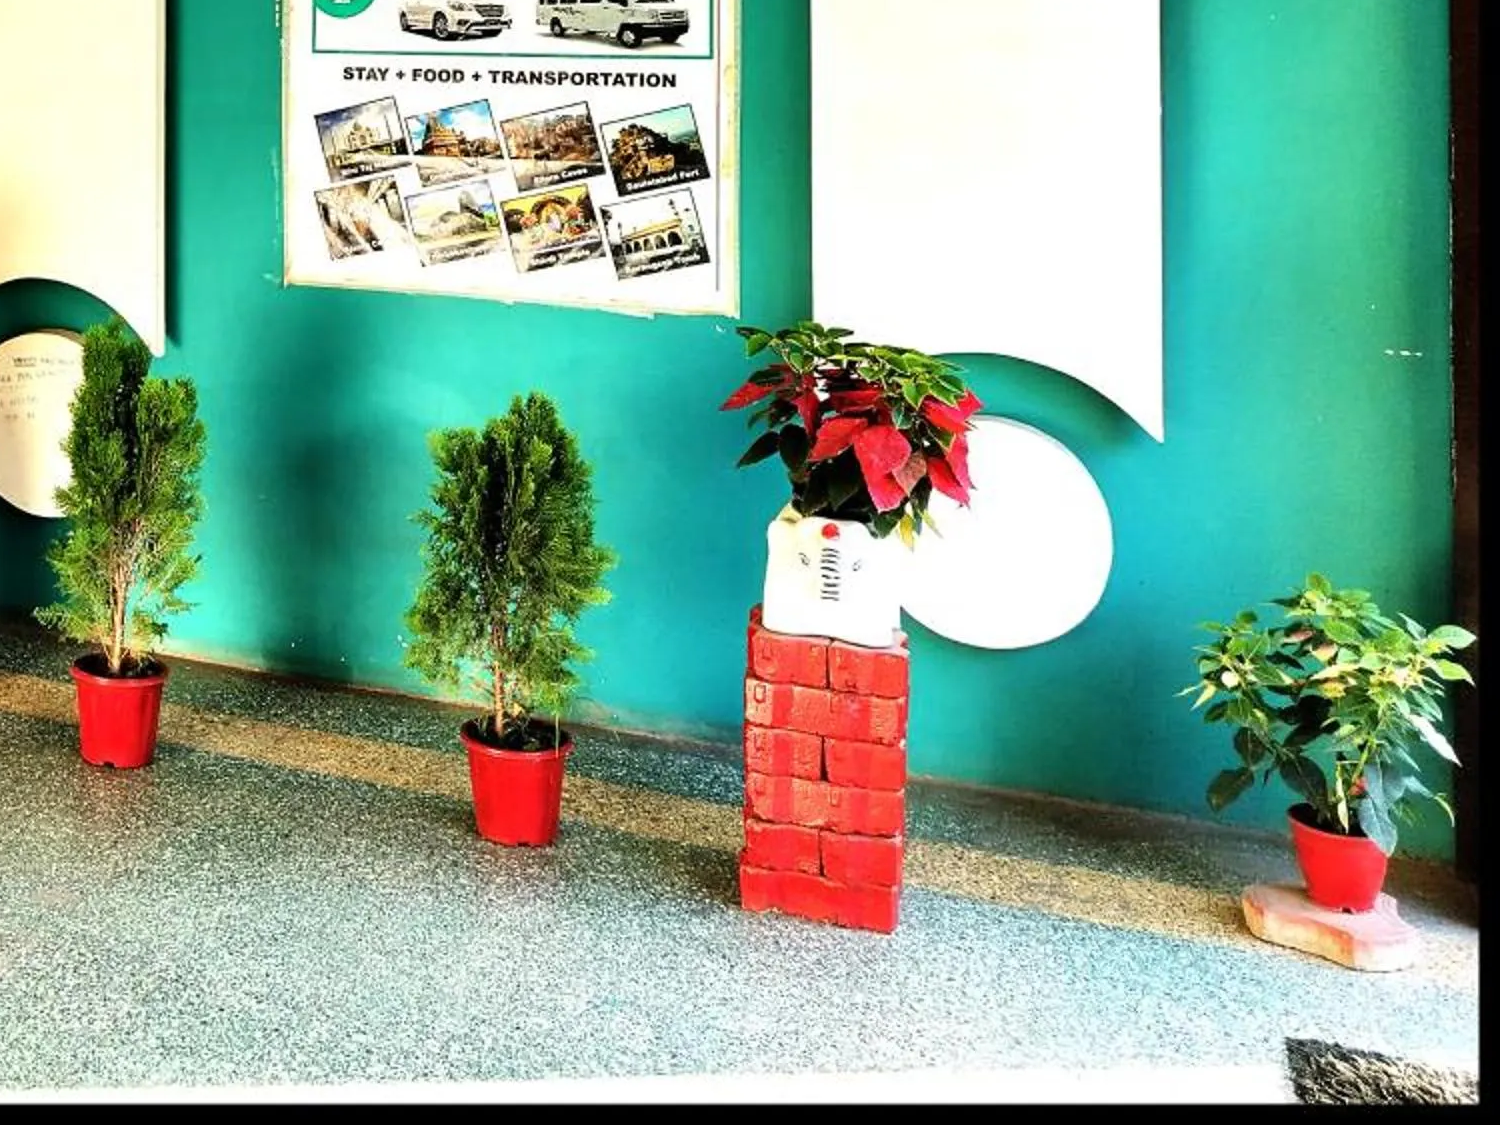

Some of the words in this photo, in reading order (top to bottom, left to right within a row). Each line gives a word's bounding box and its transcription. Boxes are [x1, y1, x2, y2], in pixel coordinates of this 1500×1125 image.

[343, 66, 390, 81] STAY
[411, 68, 465, 83] FOOD
[488, 70, 676, 88] TRANSPORTATION
